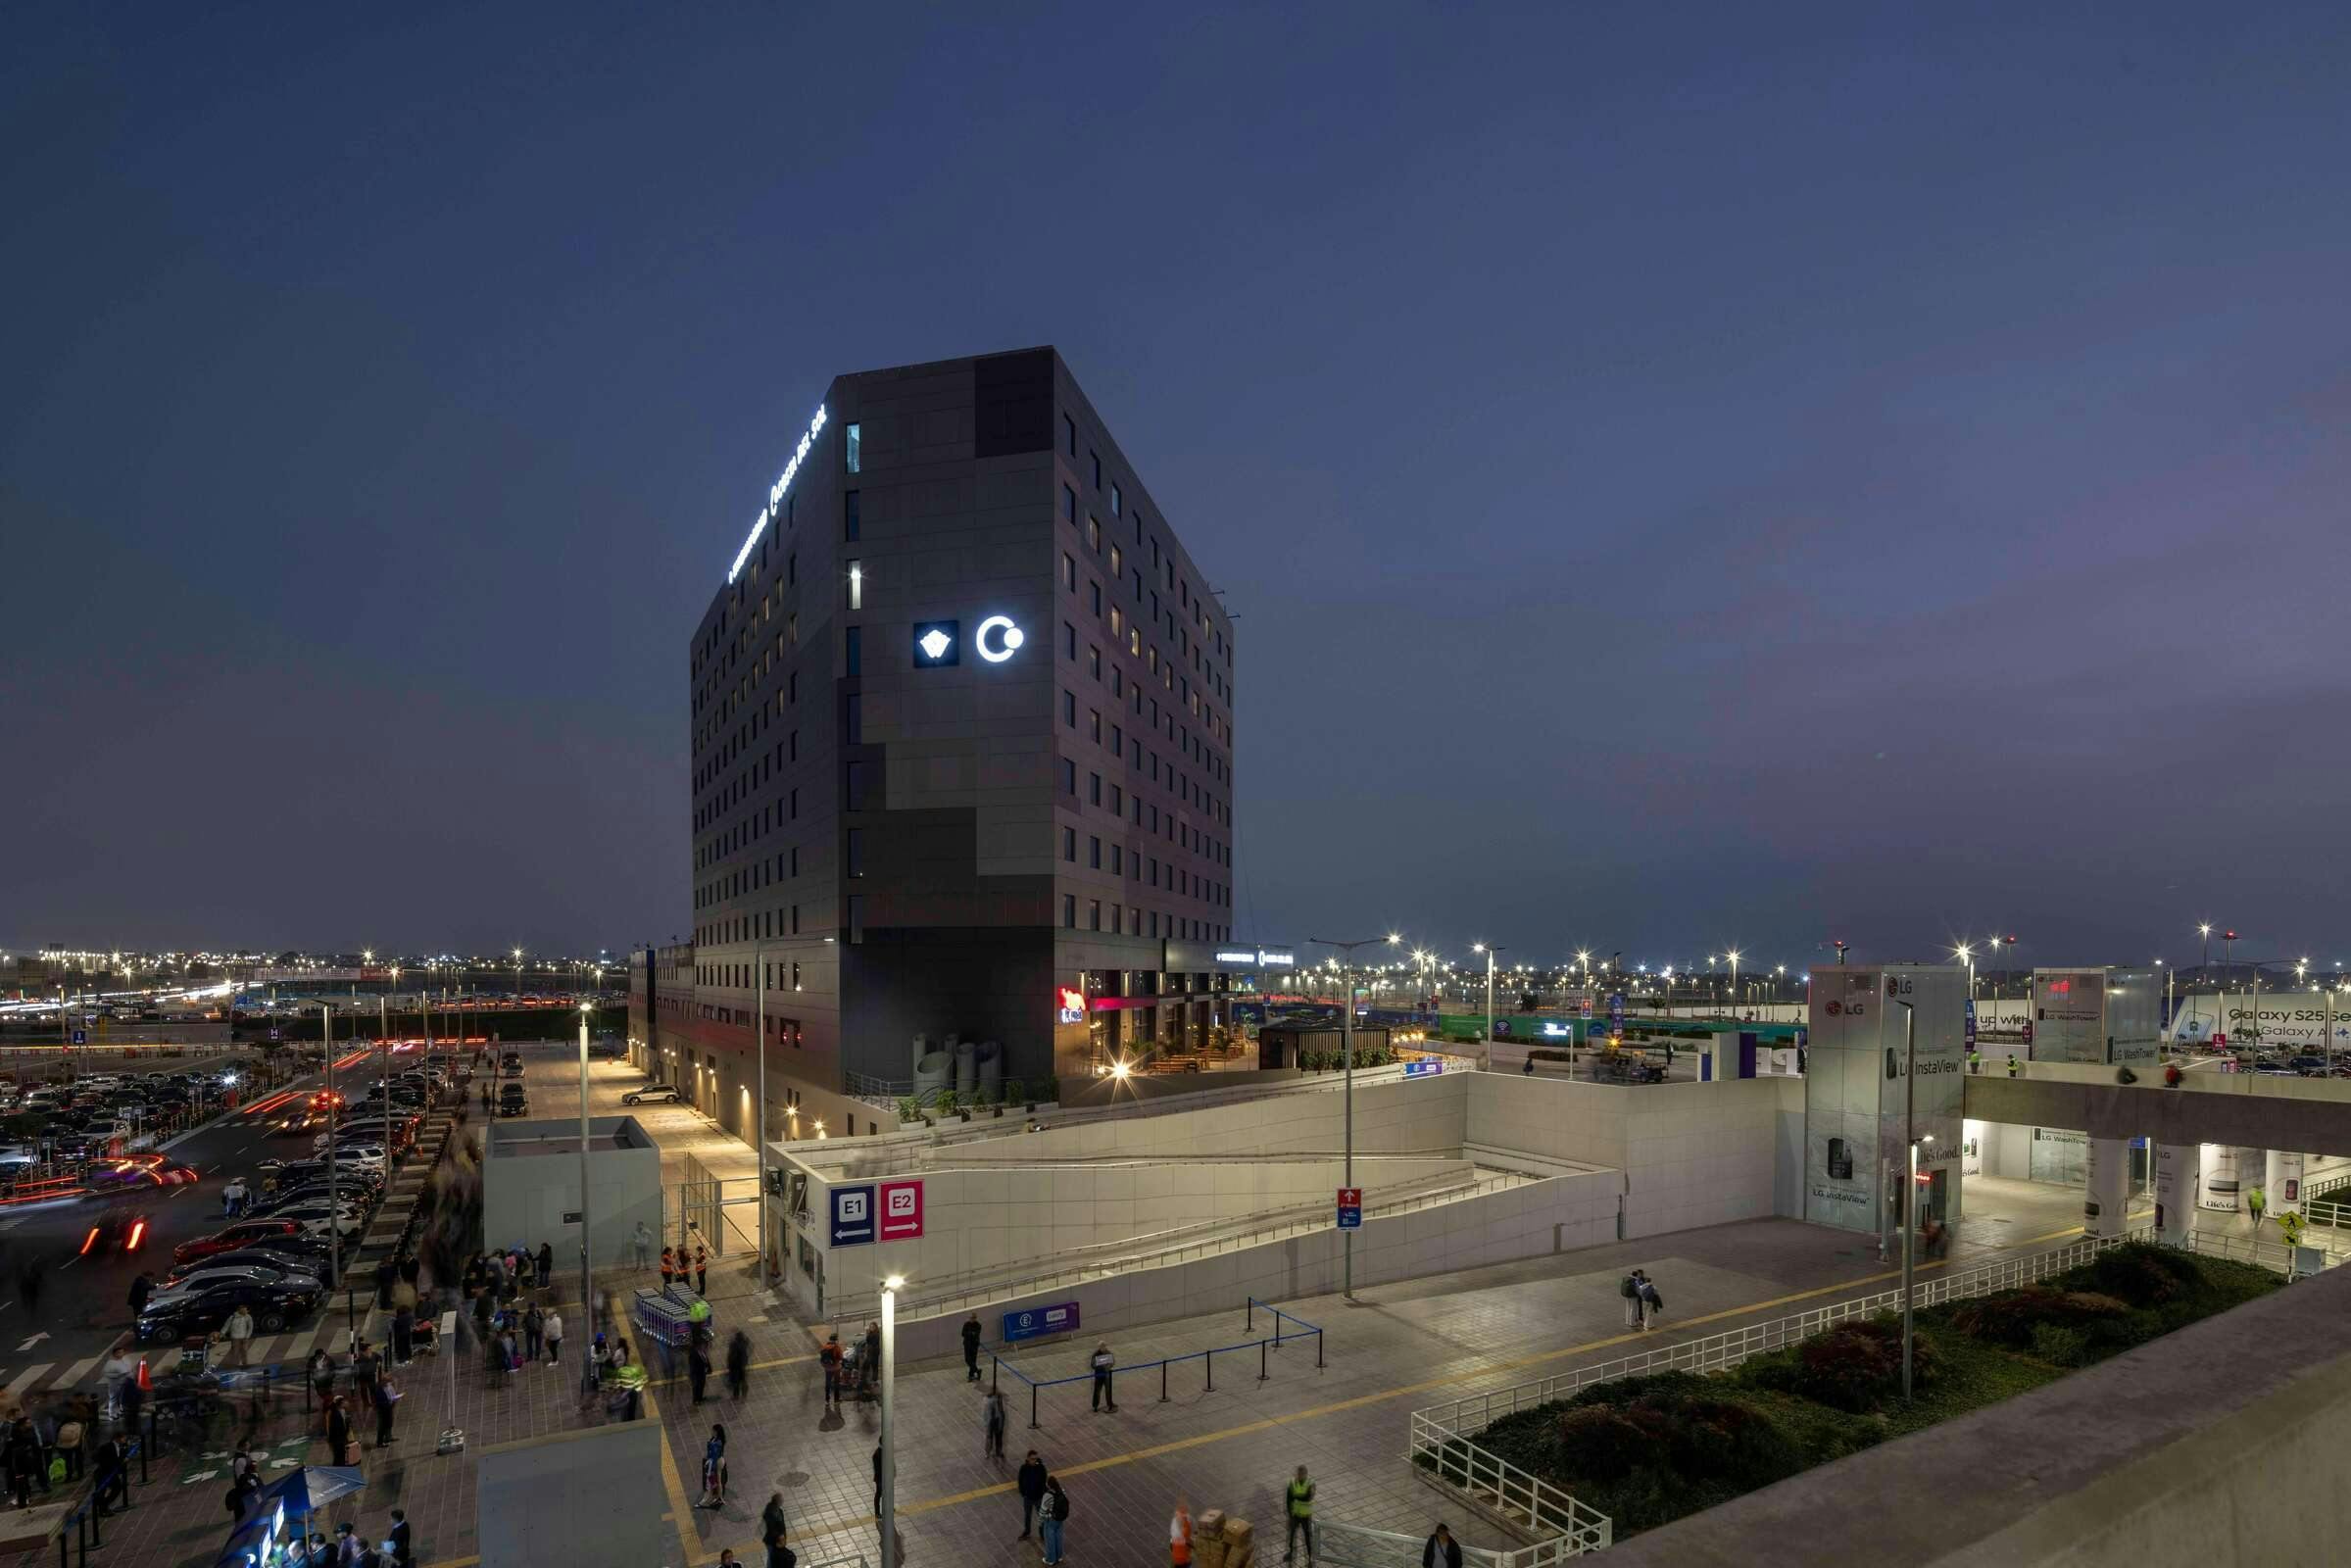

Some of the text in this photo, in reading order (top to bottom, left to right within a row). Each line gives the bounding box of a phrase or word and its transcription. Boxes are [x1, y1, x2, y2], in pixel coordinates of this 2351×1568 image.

[1899, 980, 1912, 994] LG
[1845, 1004, 1864, 1015] LG
[2295, 1010, 2325, 1021] S25
[1980, 1015, 1996, 1026] up
[2262, 1026, 2314, 1039] Galaxy
[1813, 1189, 1824, 1198] LG
[845, 1200, 861, 1214] E1
[893, 1195, 911, 1209] E2
